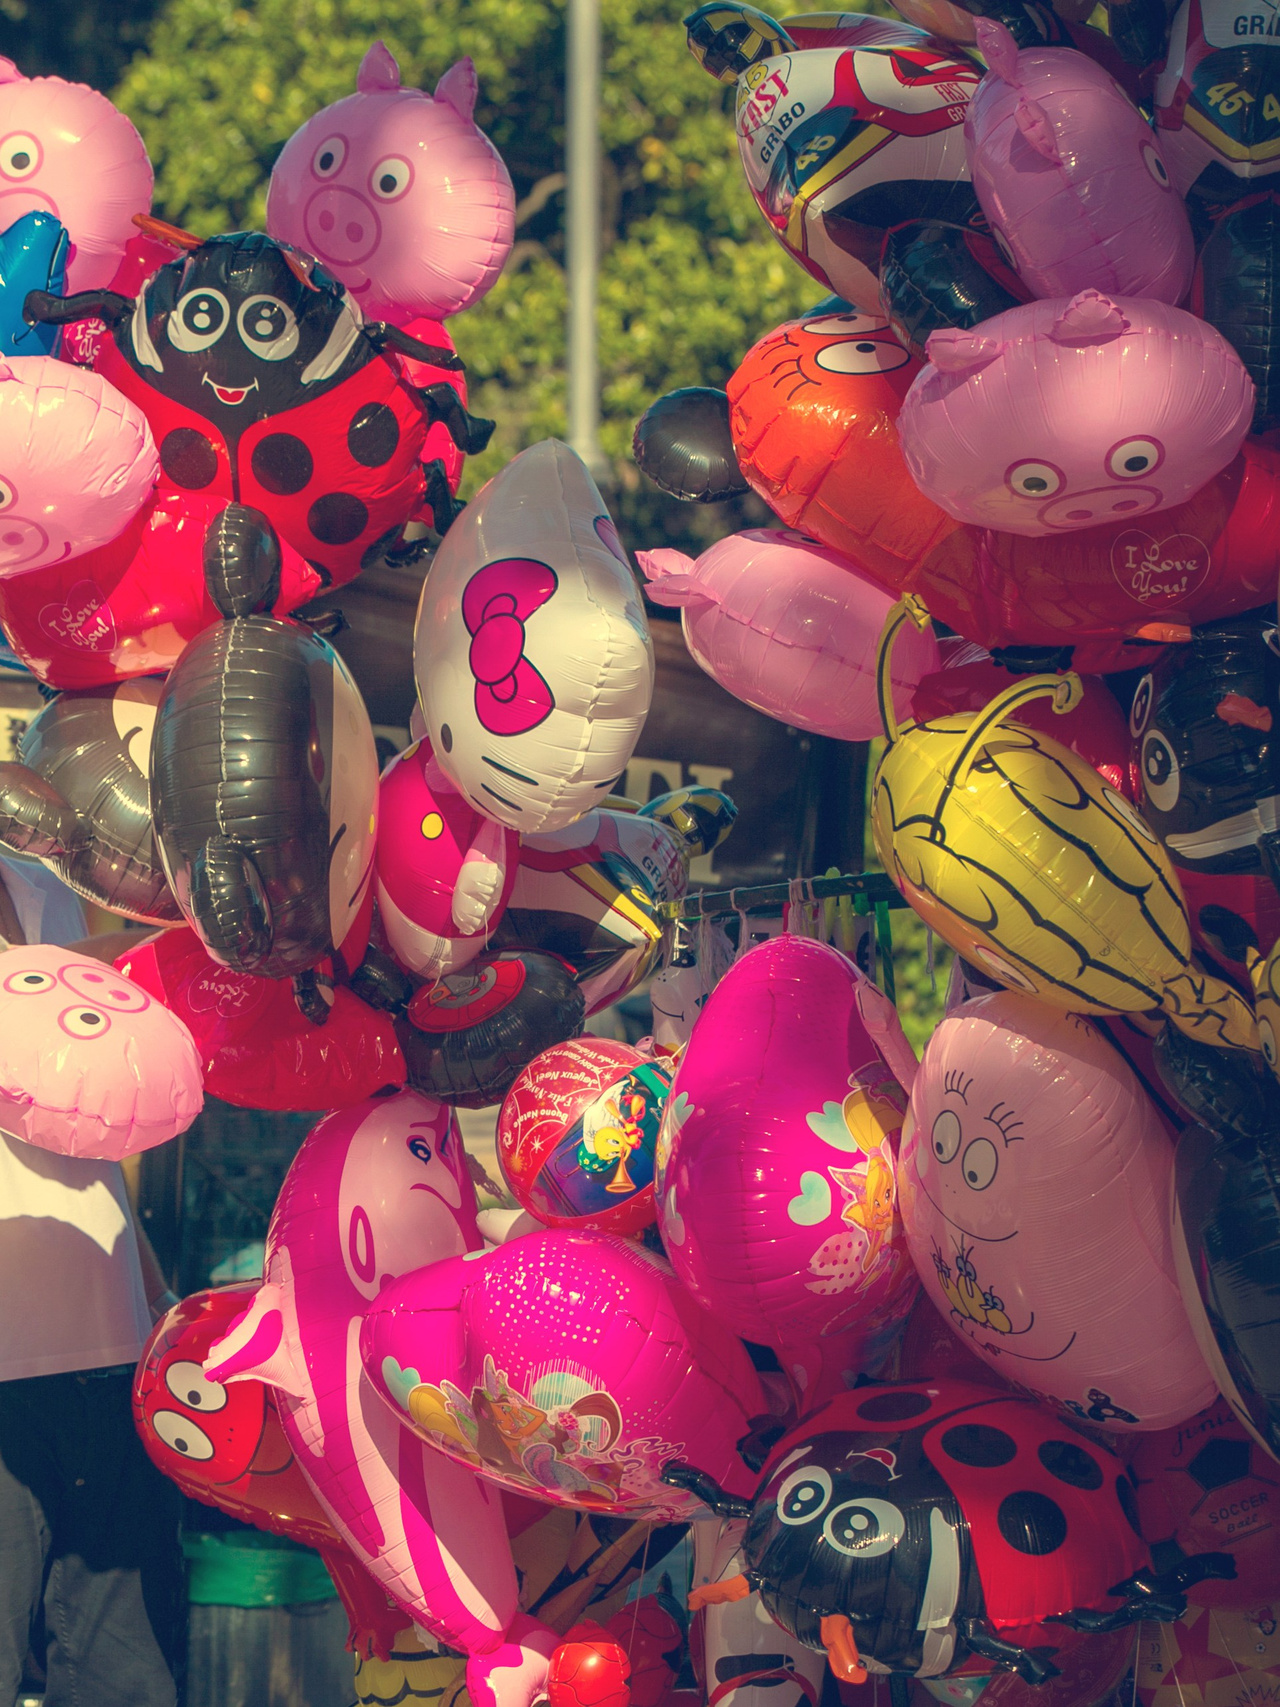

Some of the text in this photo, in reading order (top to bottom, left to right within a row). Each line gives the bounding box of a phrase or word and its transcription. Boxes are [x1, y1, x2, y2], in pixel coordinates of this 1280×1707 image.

[1140, 543, 1200, 573] Love
[1131, 571, 1189, 601] You!
[560, 1071, 600, 1088] Joyeux
